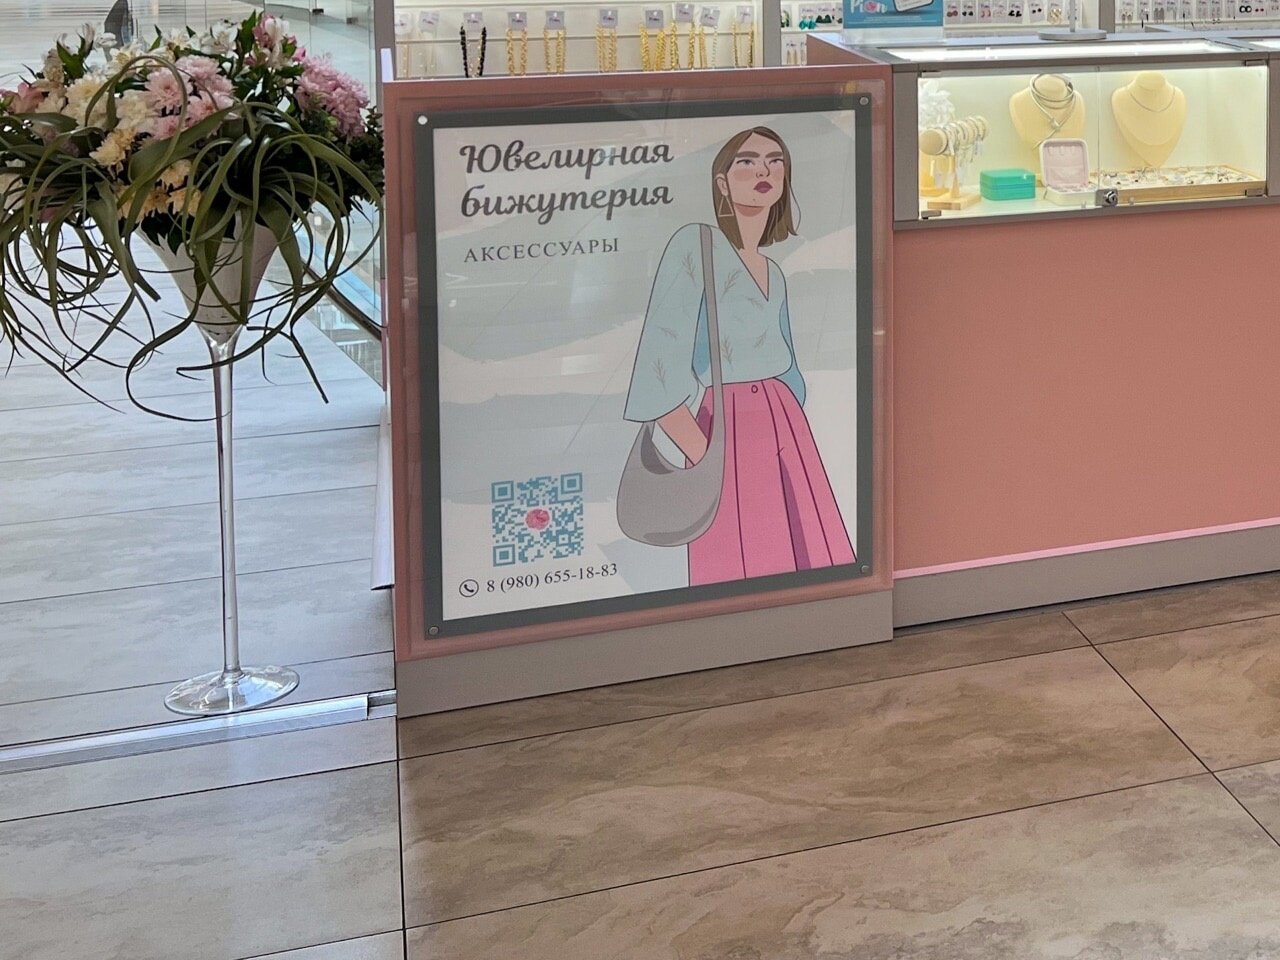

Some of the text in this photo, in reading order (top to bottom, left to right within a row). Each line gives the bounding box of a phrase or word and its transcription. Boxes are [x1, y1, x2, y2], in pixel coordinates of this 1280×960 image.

[459, 140, 674, 179] Ювелирная
[461, 185, 673, 225] бижутерия
[464, 237, 619, 263] АКСЕССУАРЫ
[486, 563, 618, 594] 8 (980) 655-18-83
